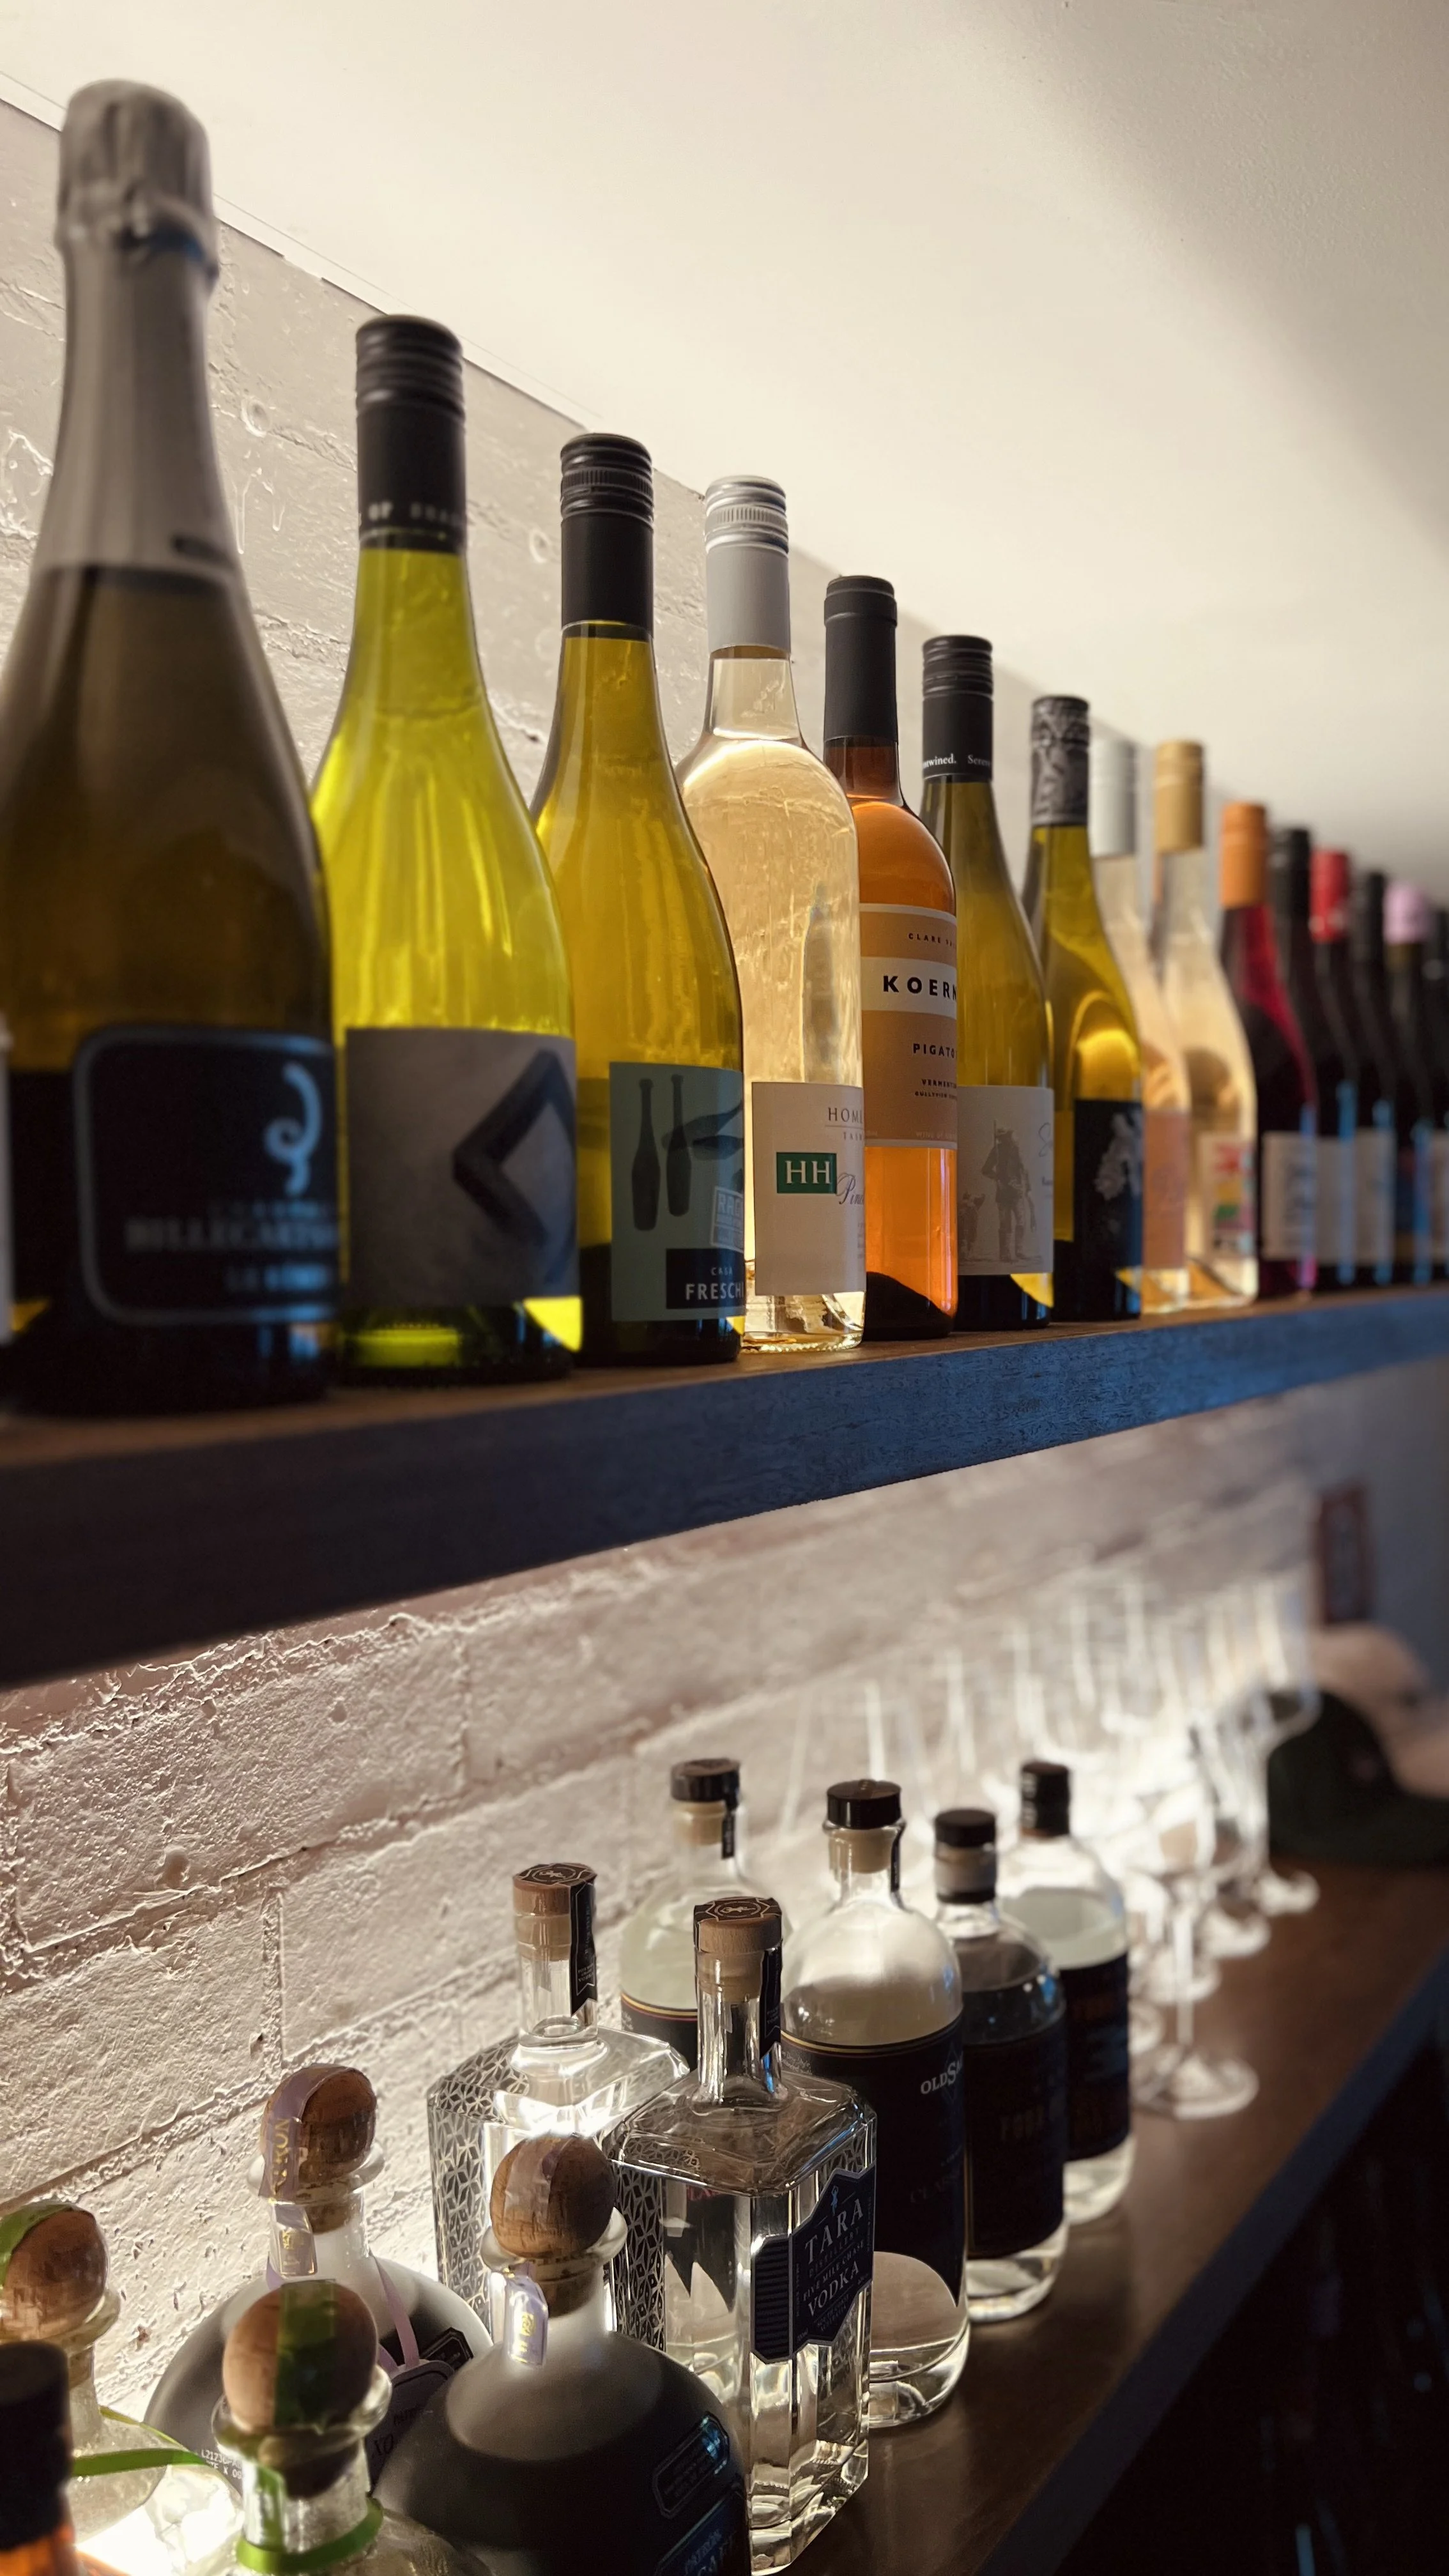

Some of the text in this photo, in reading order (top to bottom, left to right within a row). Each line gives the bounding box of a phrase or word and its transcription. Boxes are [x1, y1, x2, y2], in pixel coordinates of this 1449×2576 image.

[908, 933, 941, 944] CLARE
[913, 1043, 956, 1059] PIGATO
[785, 1160, 831, 1184] HH
[710, 1267, 733, 1275] CASA
[804, 2198, 863, 2265] TARA
[808, 2260, 859, 2317] VODKA
